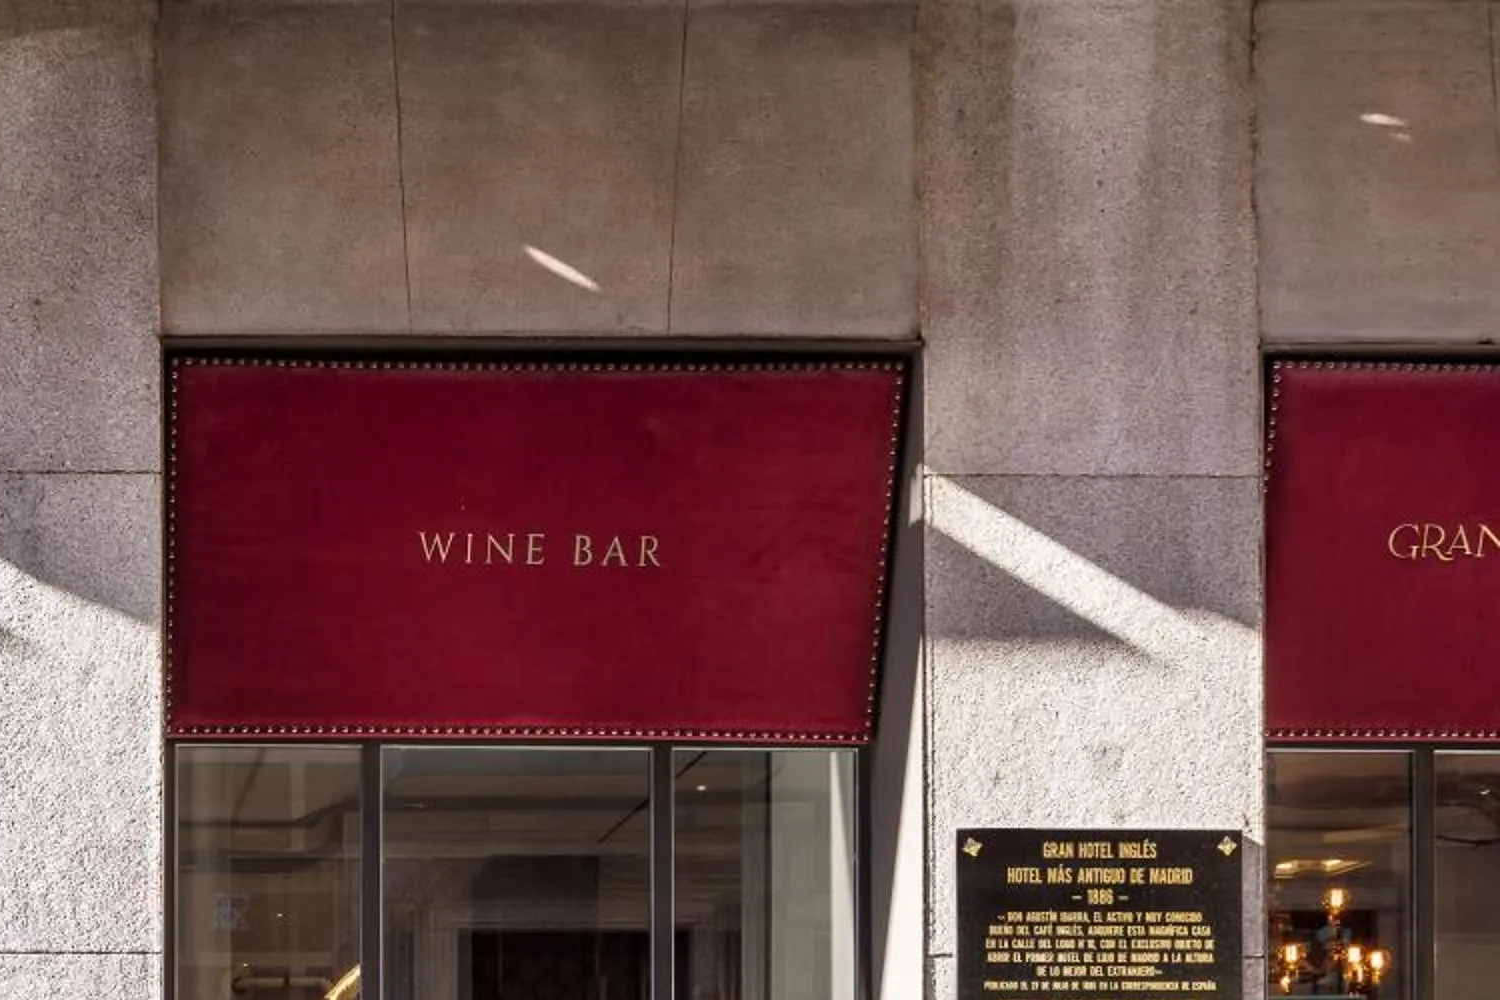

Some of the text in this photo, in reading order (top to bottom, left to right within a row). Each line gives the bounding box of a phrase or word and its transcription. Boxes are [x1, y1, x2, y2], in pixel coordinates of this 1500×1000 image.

[418, 531, 662, 568] WINE BAR
[1042, 838, 1157, 859] GRAN HOTEL INGLÉS
[1007, 864, 1193, 884] HOTEL MÁS ANTIGUO DE MADRID
